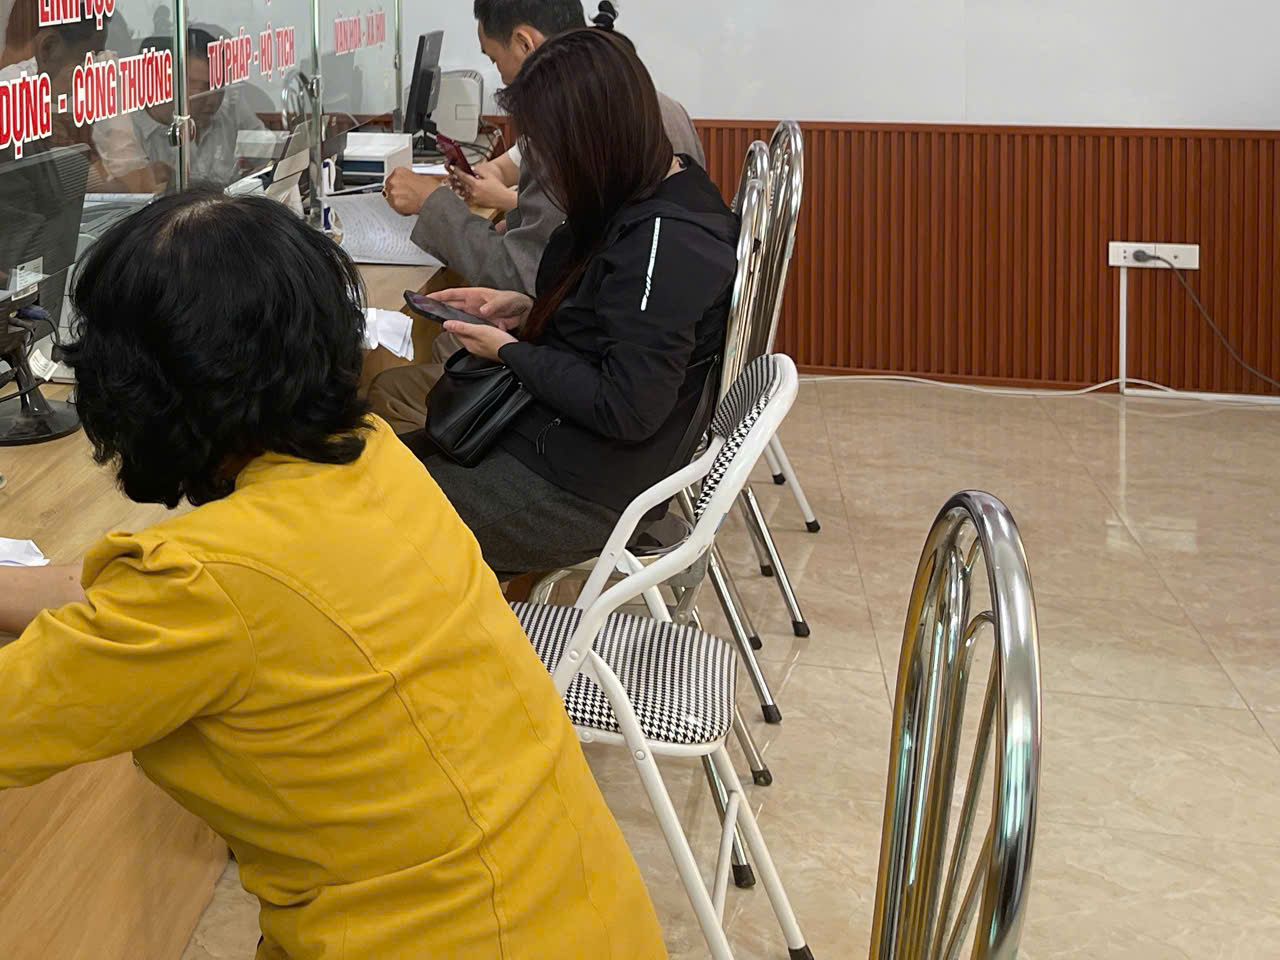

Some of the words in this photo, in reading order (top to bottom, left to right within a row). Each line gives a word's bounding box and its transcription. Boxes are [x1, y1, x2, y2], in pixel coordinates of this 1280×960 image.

[74, 56, 116, 122] CÔNG
[120, 52, 172, 110] THƯƠNG
[208, 42, 223, 86] TƯ
[224, 28, 251, 82] PHÁP
